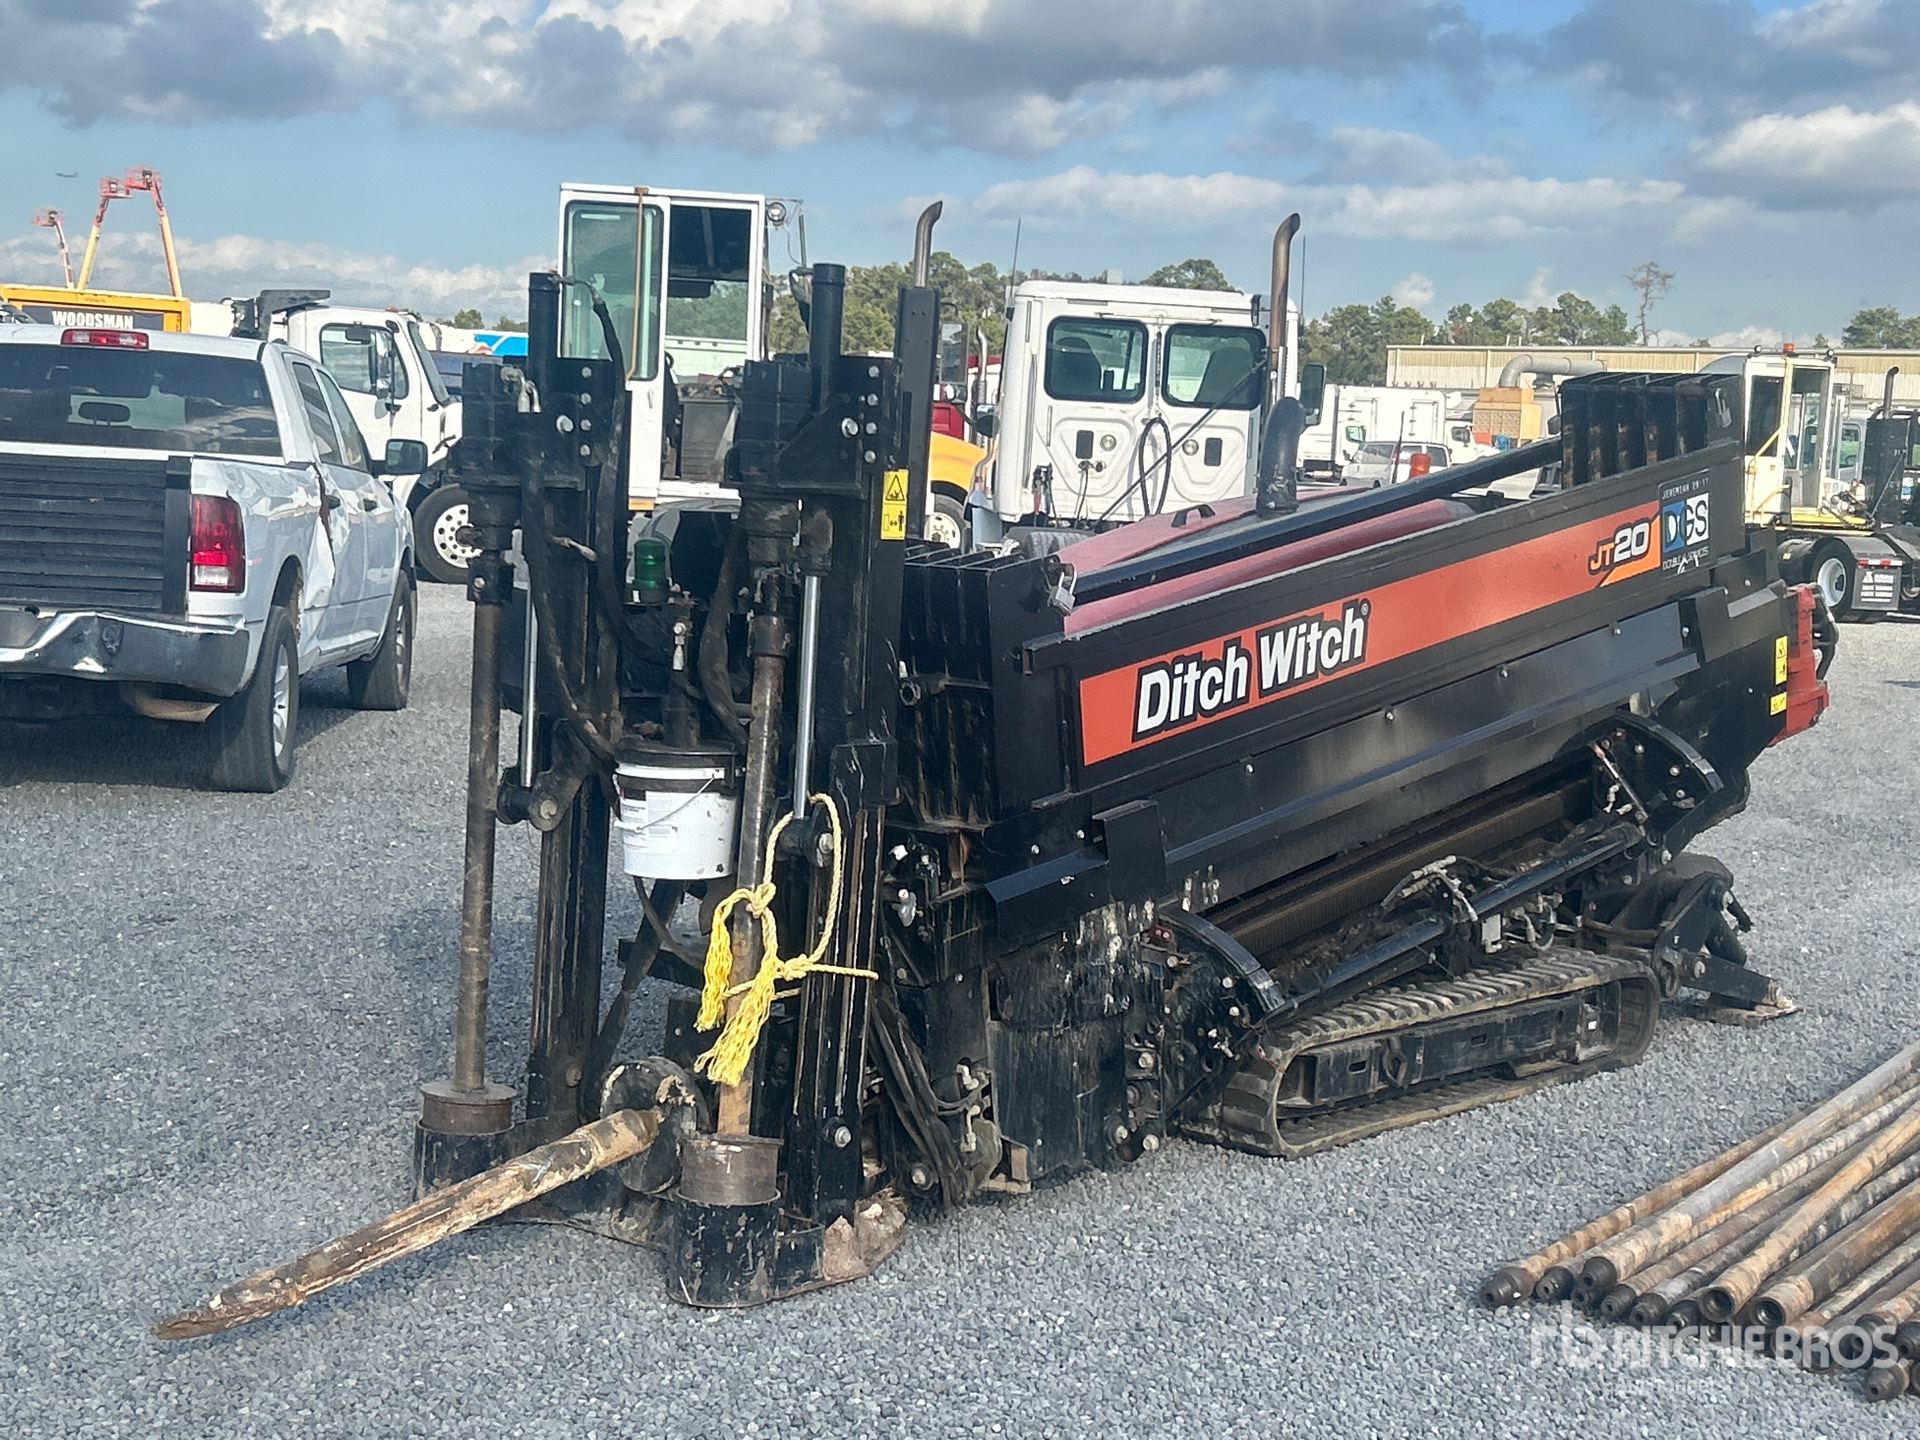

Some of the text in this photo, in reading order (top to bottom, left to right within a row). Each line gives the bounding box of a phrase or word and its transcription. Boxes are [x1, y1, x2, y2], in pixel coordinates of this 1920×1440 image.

[52, 310, 134, 329] WOODSMAN
[1589, 521, 1650, 571] JT20
[1136, 645, 1250, 734] Ditch
